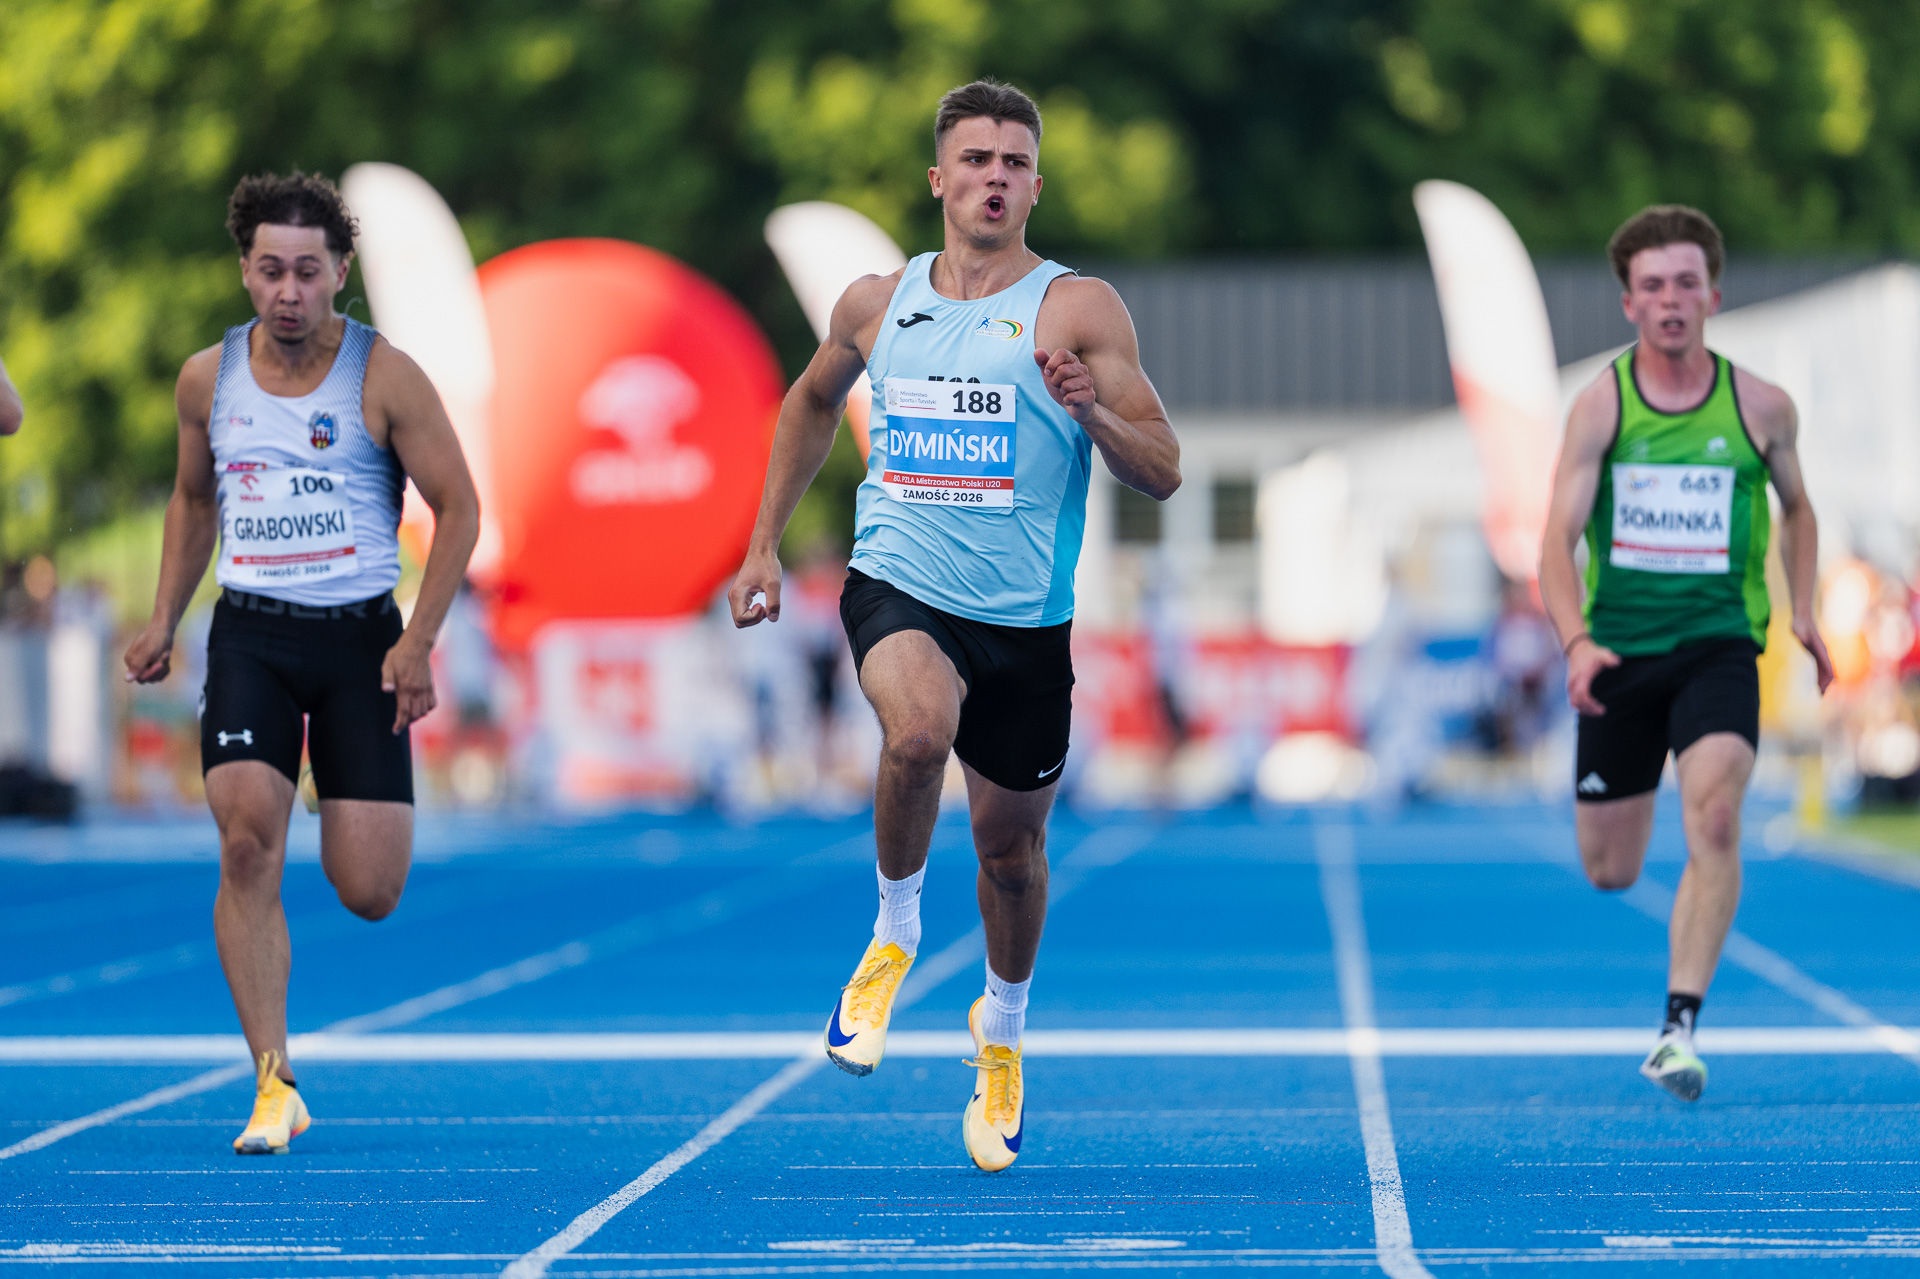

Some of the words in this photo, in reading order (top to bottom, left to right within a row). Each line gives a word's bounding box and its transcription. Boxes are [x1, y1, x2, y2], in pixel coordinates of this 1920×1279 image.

[900, 390, 928, 398] Ministerstwo
[952, 390, 1002, 415] 188
[890, 428, 1008, 463] DYMIŃSKI
[289, 475, 334, 496] 100
[893, 474, 901, 482] 80.
[902, 475, 915, 484] PZLA
[916, 477, 960, 487] Mistrzostwa
[961, 480, 984, 488] Polski
[985, 480, 1001, 488] U20
[902, 488, 950, 501] ZAMOŚĆ
[953, 492, 983, 503] 2026
[235, 508, 345, 541] GRABOWSKI
[1619, 503, 1723, 533] SOMINKA
